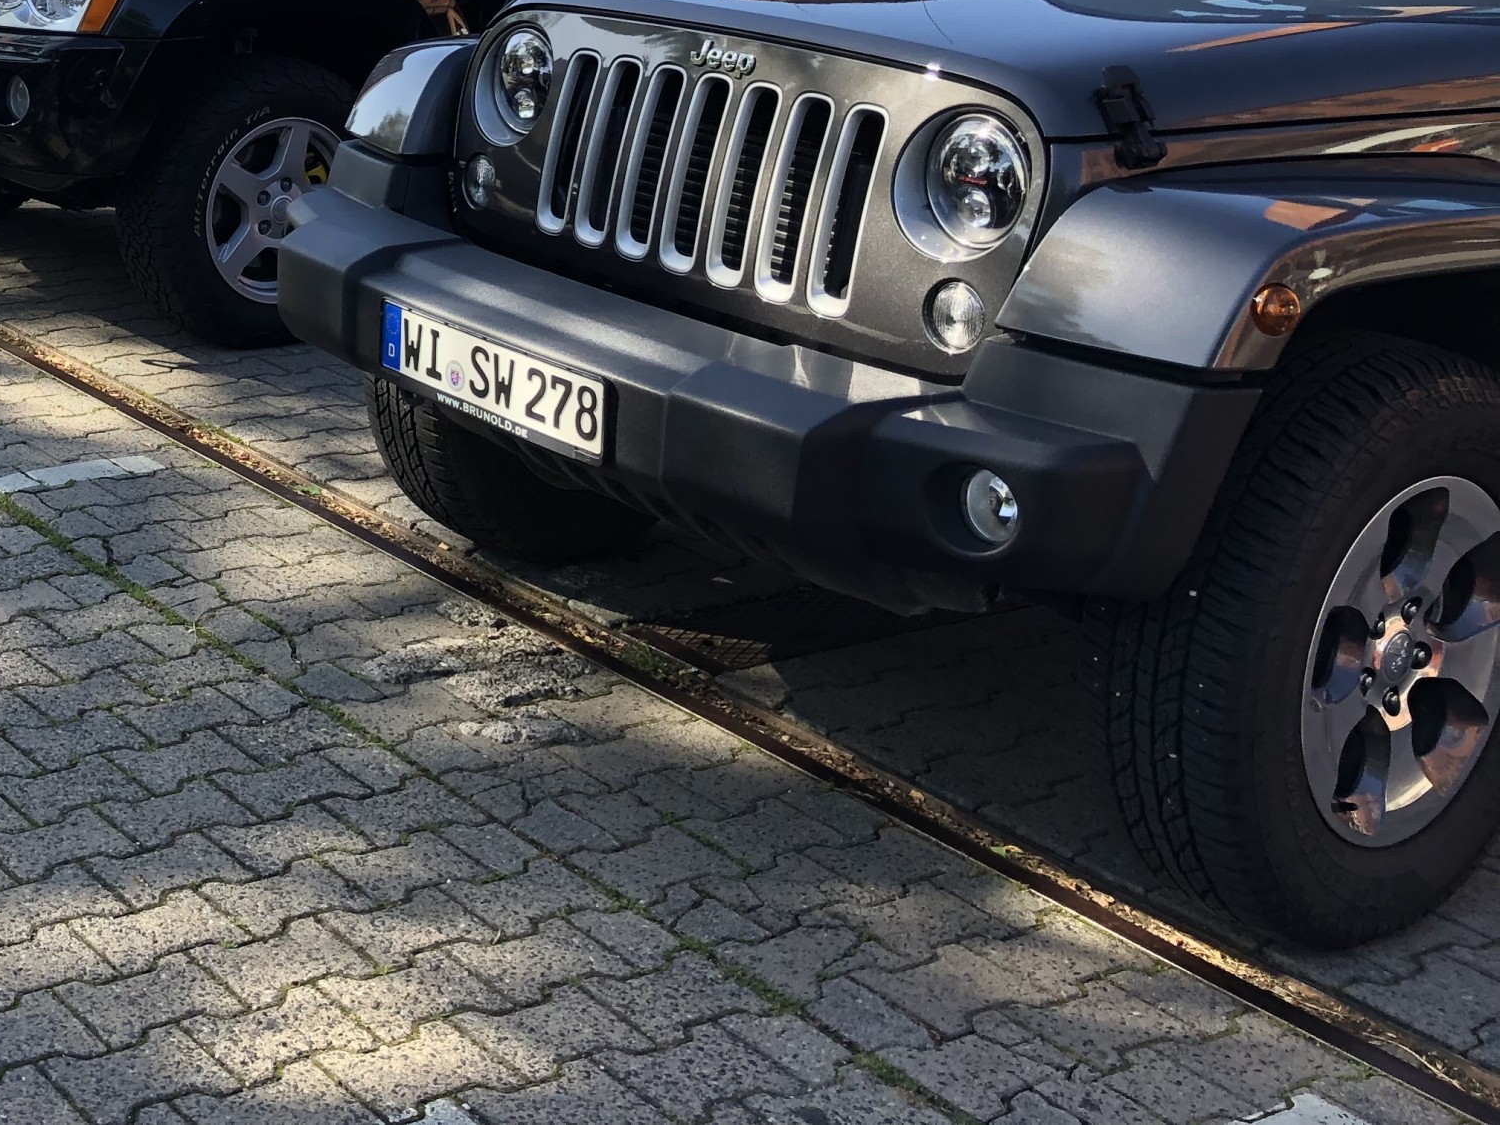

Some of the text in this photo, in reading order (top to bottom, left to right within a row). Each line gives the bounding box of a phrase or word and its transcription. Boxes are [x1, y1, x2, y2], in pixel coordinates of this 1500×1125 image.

[690, 37, 757, 80] Jeep
[193, 106, 271, 238] All-Terrain T/A
[388, 317, 599, 442] D WI SW 278
[436, 392, 529, 439] WWW.BRUNOLD.DE
